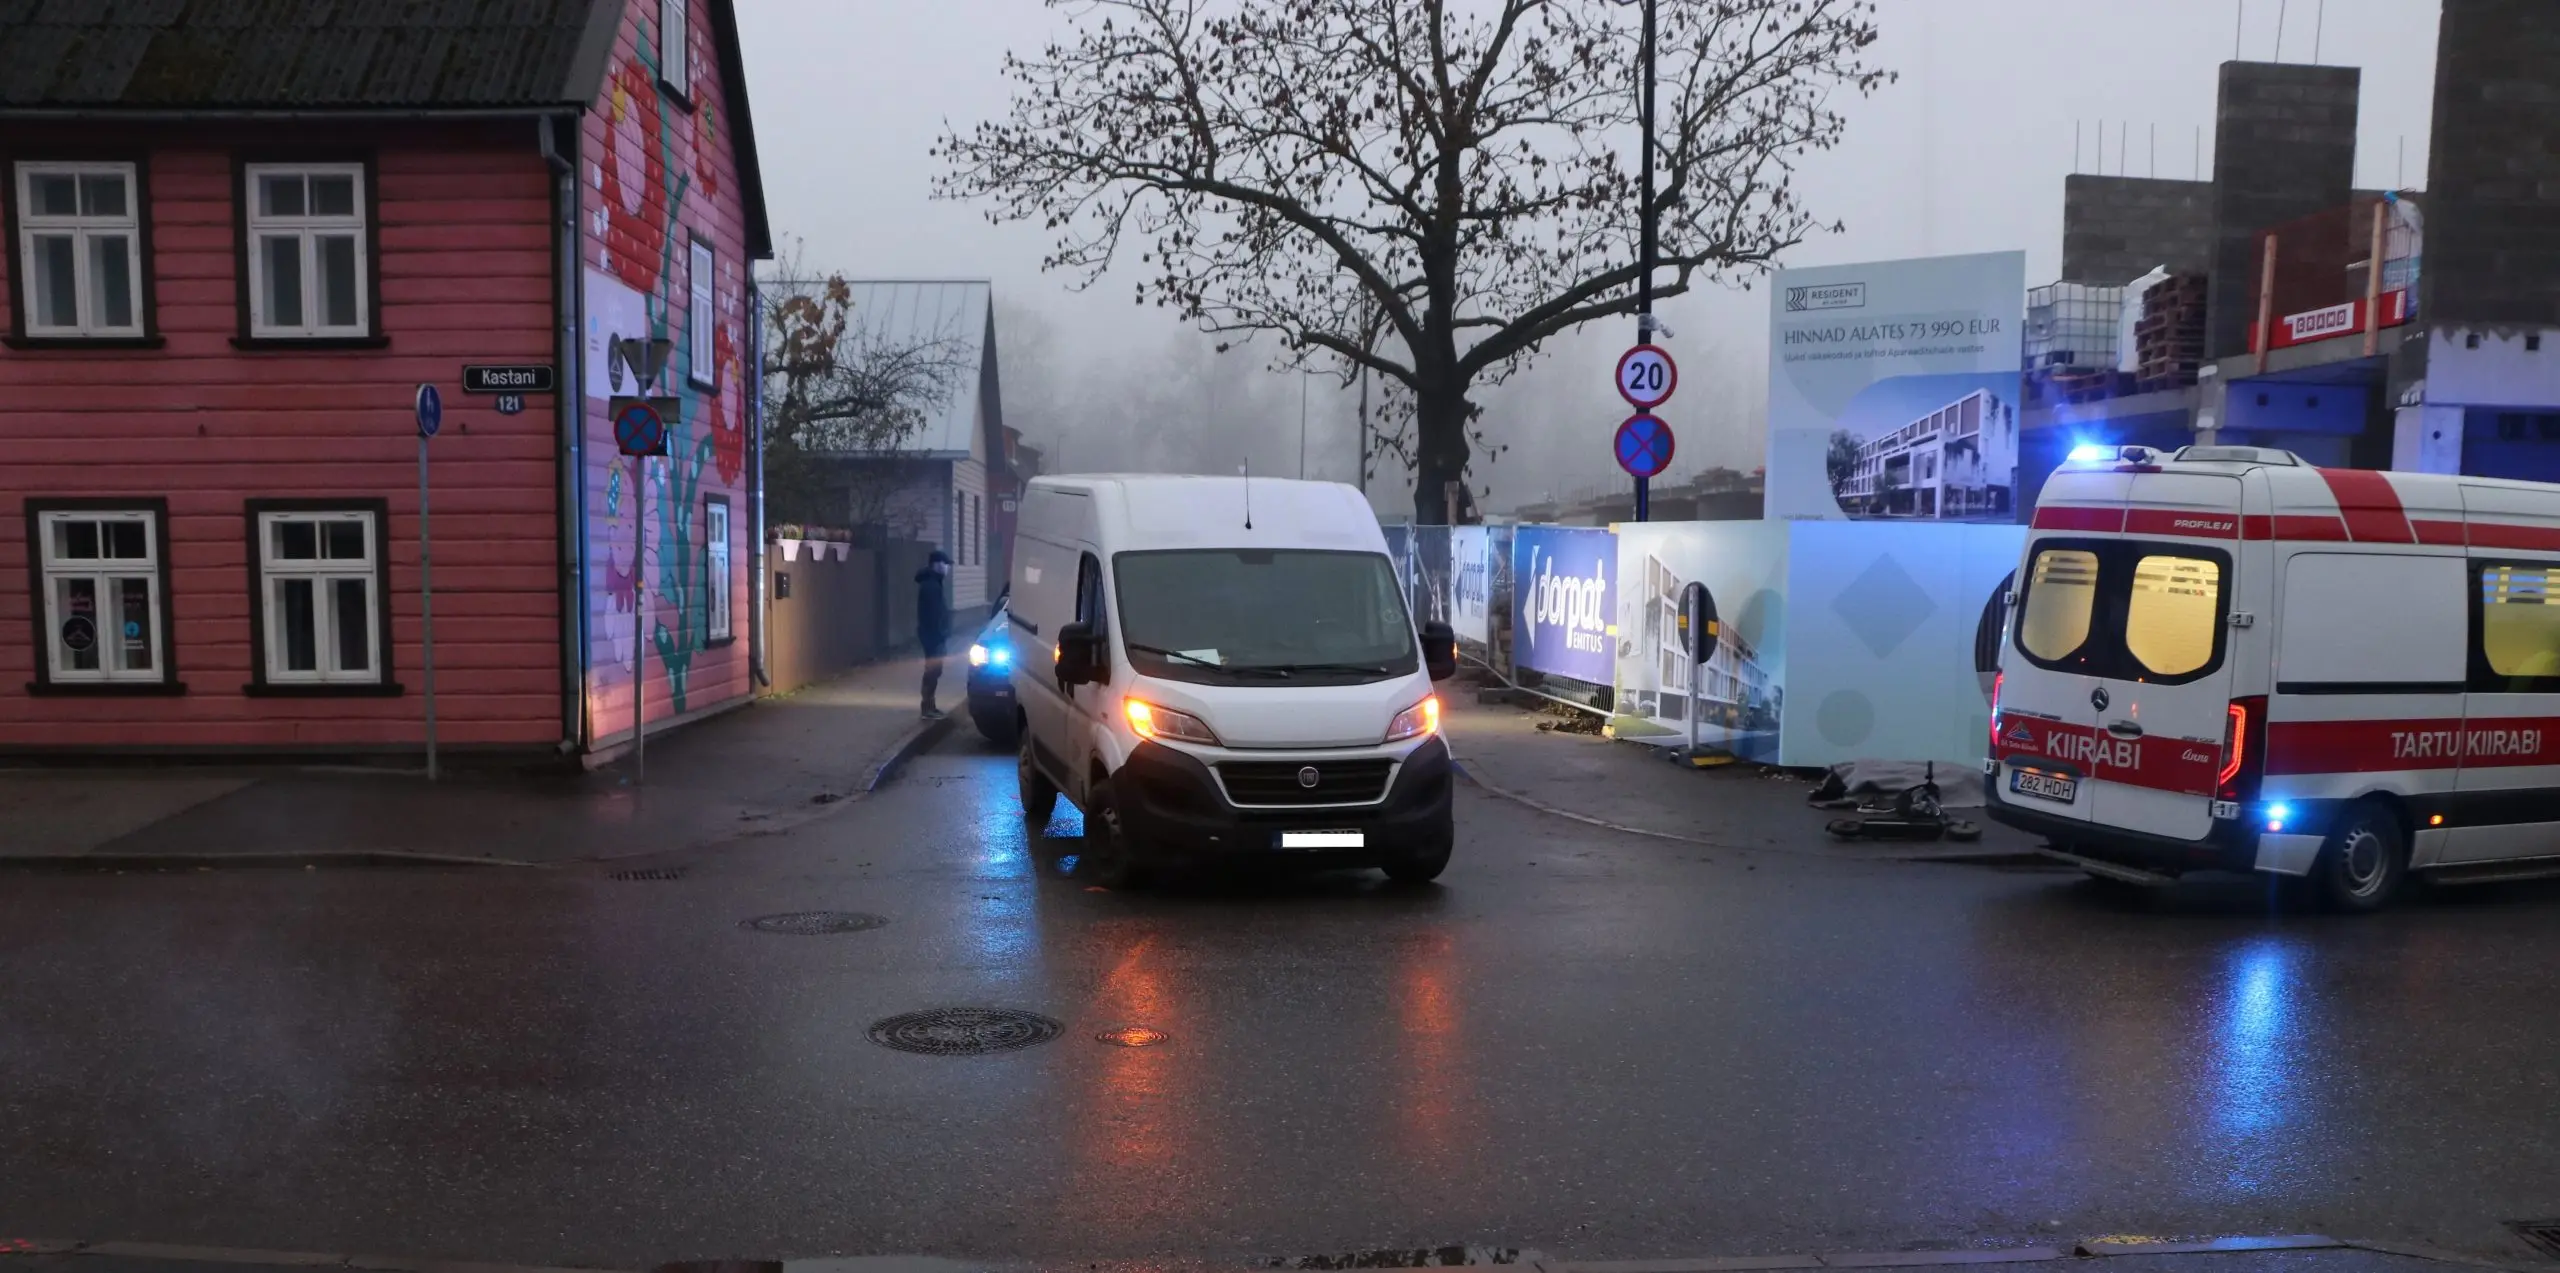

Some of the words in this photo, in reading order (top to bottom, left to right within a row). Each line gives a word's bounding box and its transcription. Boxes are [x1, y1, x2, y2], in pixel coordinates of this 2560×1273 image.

[1811, 288, 1859, 299] RESIDENT
[1784, 326, 1846, 345] HINNAD
[1850, 323, 1905, 342] ALATES
[1909, 321, 1927, 339] 73
[1931, 319, 1964, 337] 990
[1969, 317, 2001, 334] EUR
[482, 369, 535, 385] Kastani
[1629, 361, 1663, 391] 20
[499, 396, 519, 411] 121
[2174, 520, 2221, 530] PROFILE
[1537, 555, 1606, 649] dorpat
[1573, 631, 1604, 653] EHITUS
[2046, 730, 2141, 770] KIIRABI
[2391, 731, 2460, 758] TARTU
[2466, 729, 2542, 756] KIIRABI
[2020, 774, 2041, 791] 282
[2043, 778, 2071, 800] HDH
